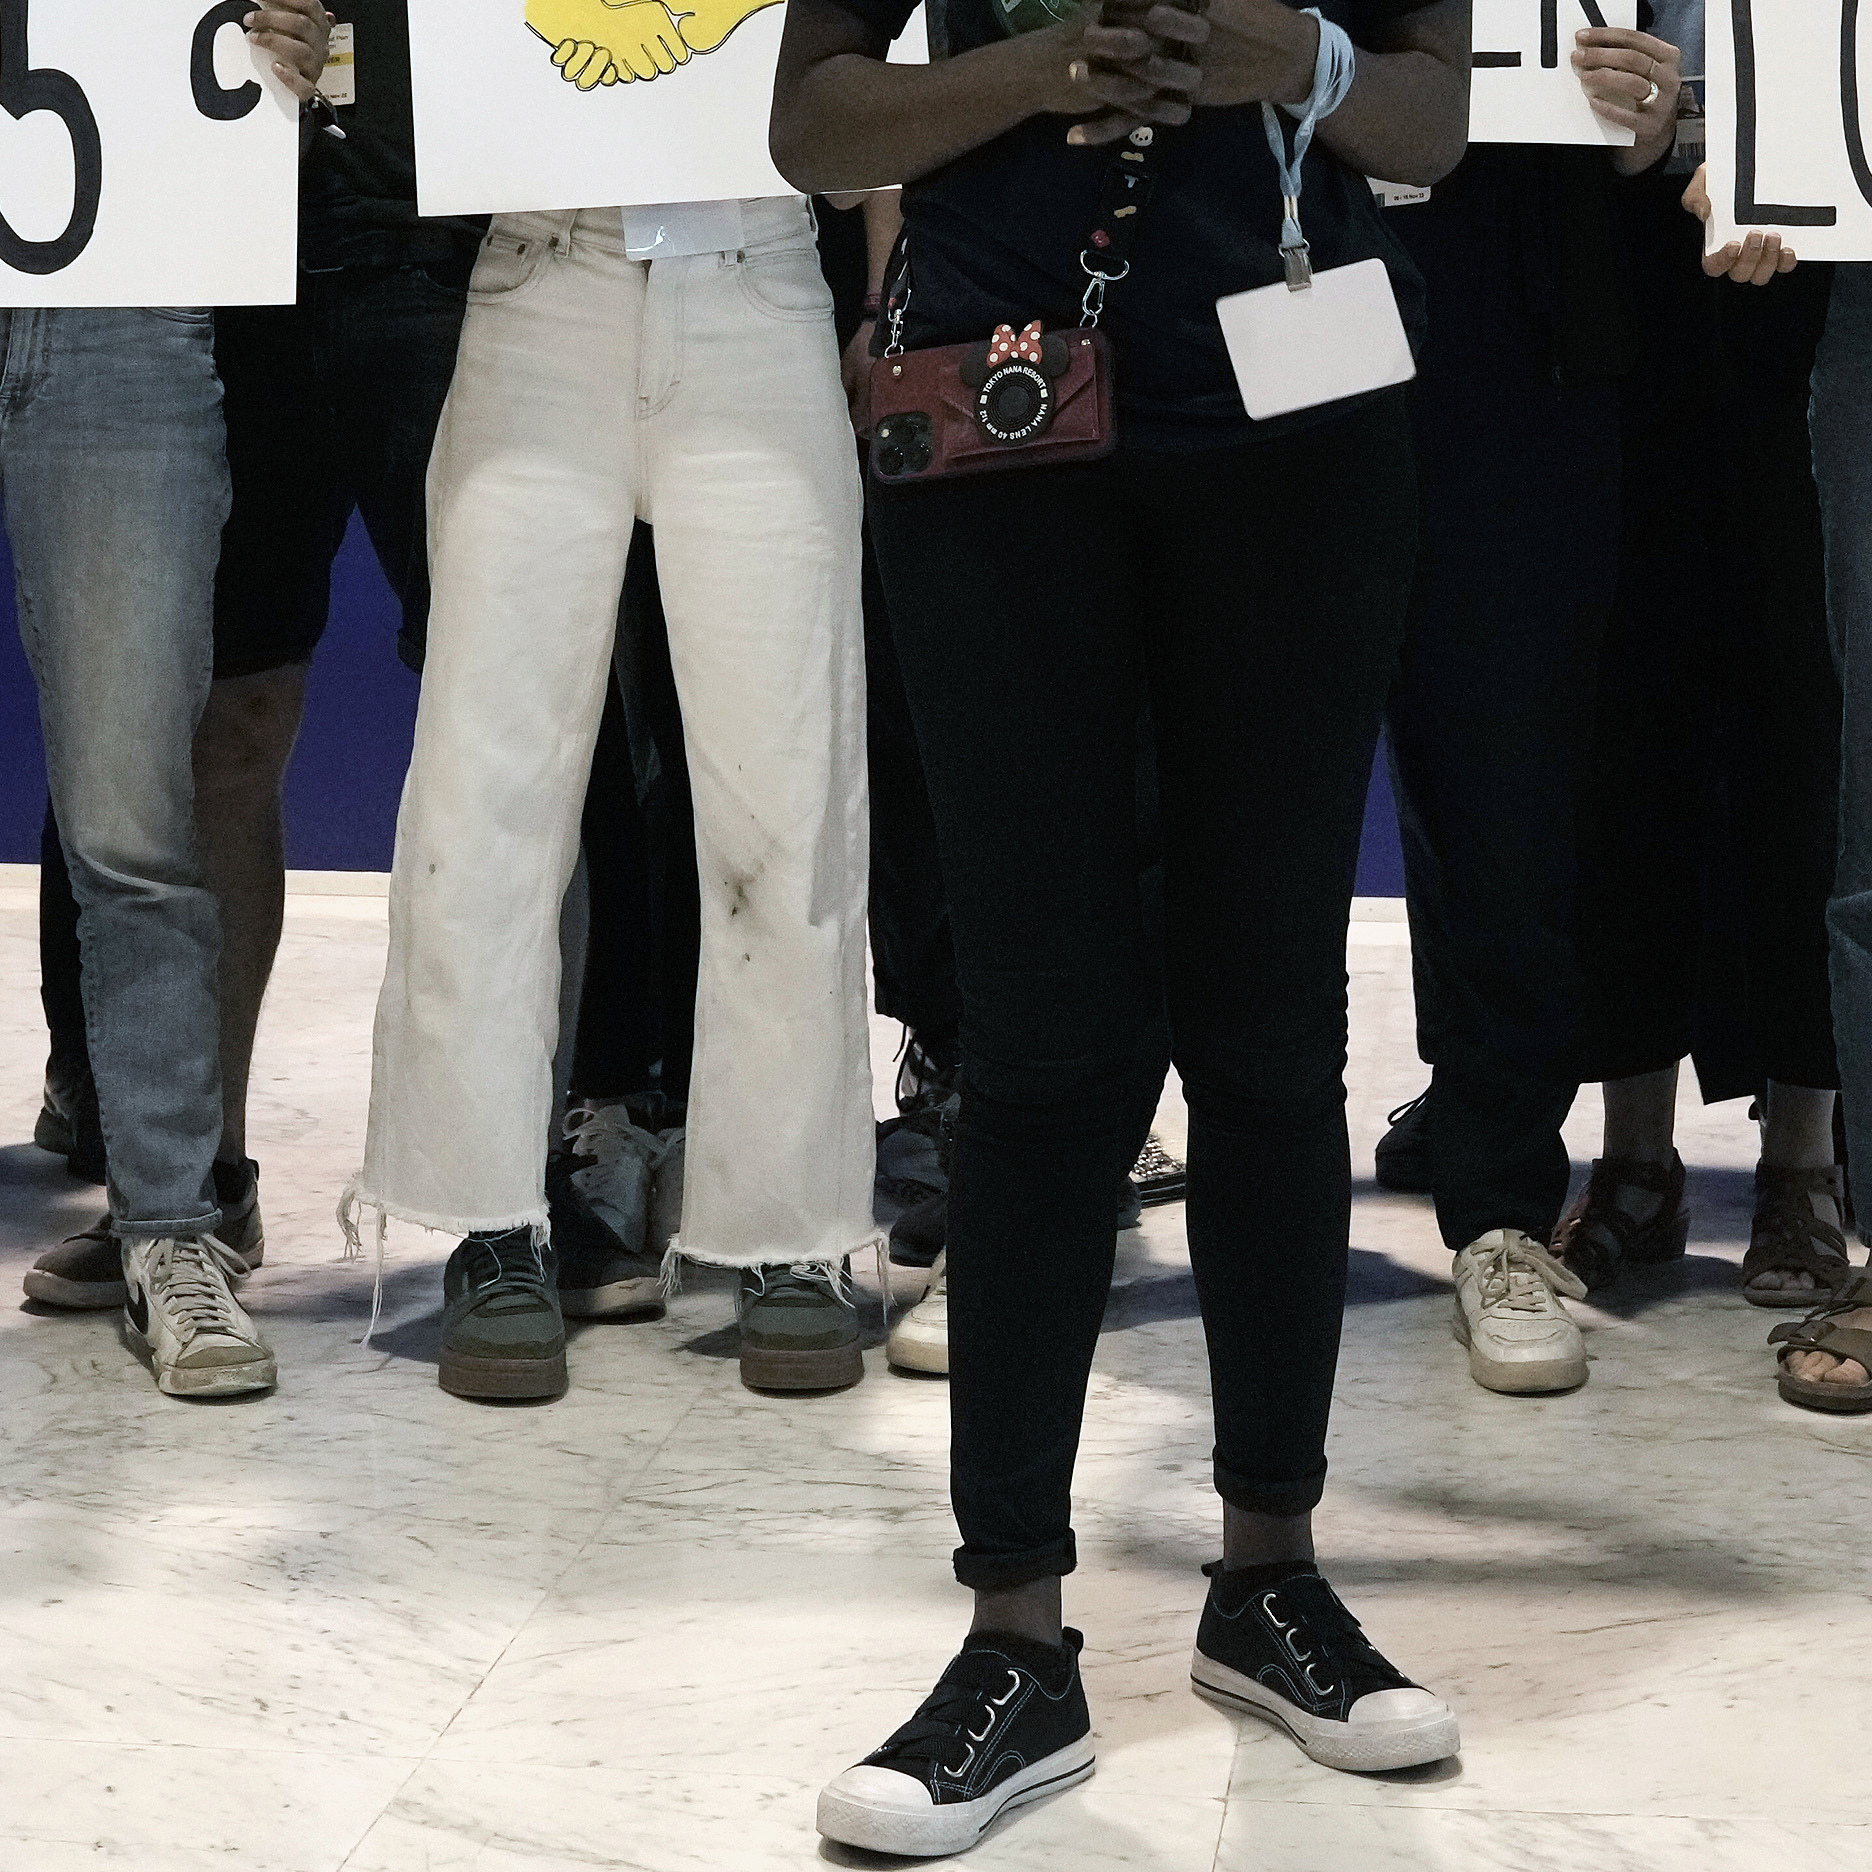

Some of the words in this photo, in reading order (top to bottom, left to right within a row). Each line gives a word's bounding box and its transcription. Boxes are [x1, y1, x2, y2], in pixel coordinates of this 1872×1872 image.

[983, 371, 1003, 393] TOKYO
[1003, 365, 1022, 375] NANA
[1030, 403, 1047, 427] NANA
[997, 431, 1008, 440] 40
[1009, 425, 1032, 440] LENS
